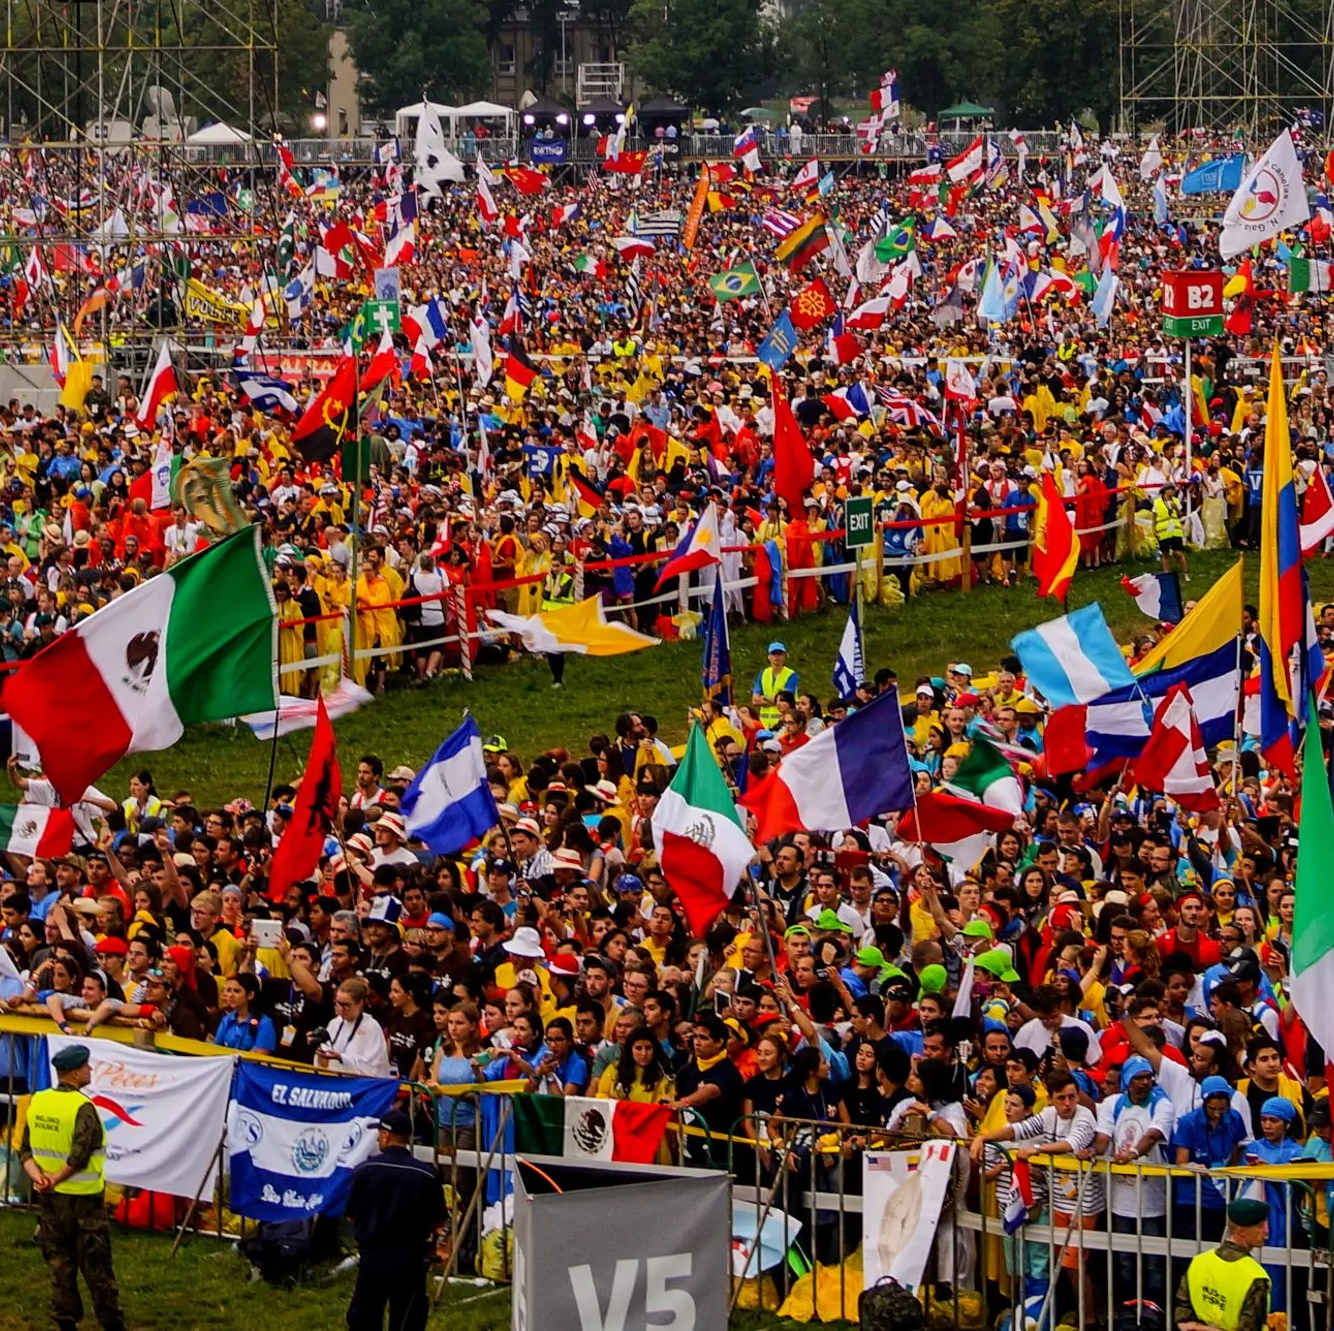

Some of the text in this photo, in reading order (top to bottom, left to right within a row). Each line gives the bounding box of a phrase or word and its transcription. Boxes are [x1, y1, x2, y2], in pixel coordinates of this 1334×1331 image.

[1187, 284, 1214, 309] B2
[1191, 319, 1211, 330] EXIT
[850, 512, 870, 531] EXIT
[272, 1084, 287, 1104] EL
[568, 1253, 696, 1331] V5
